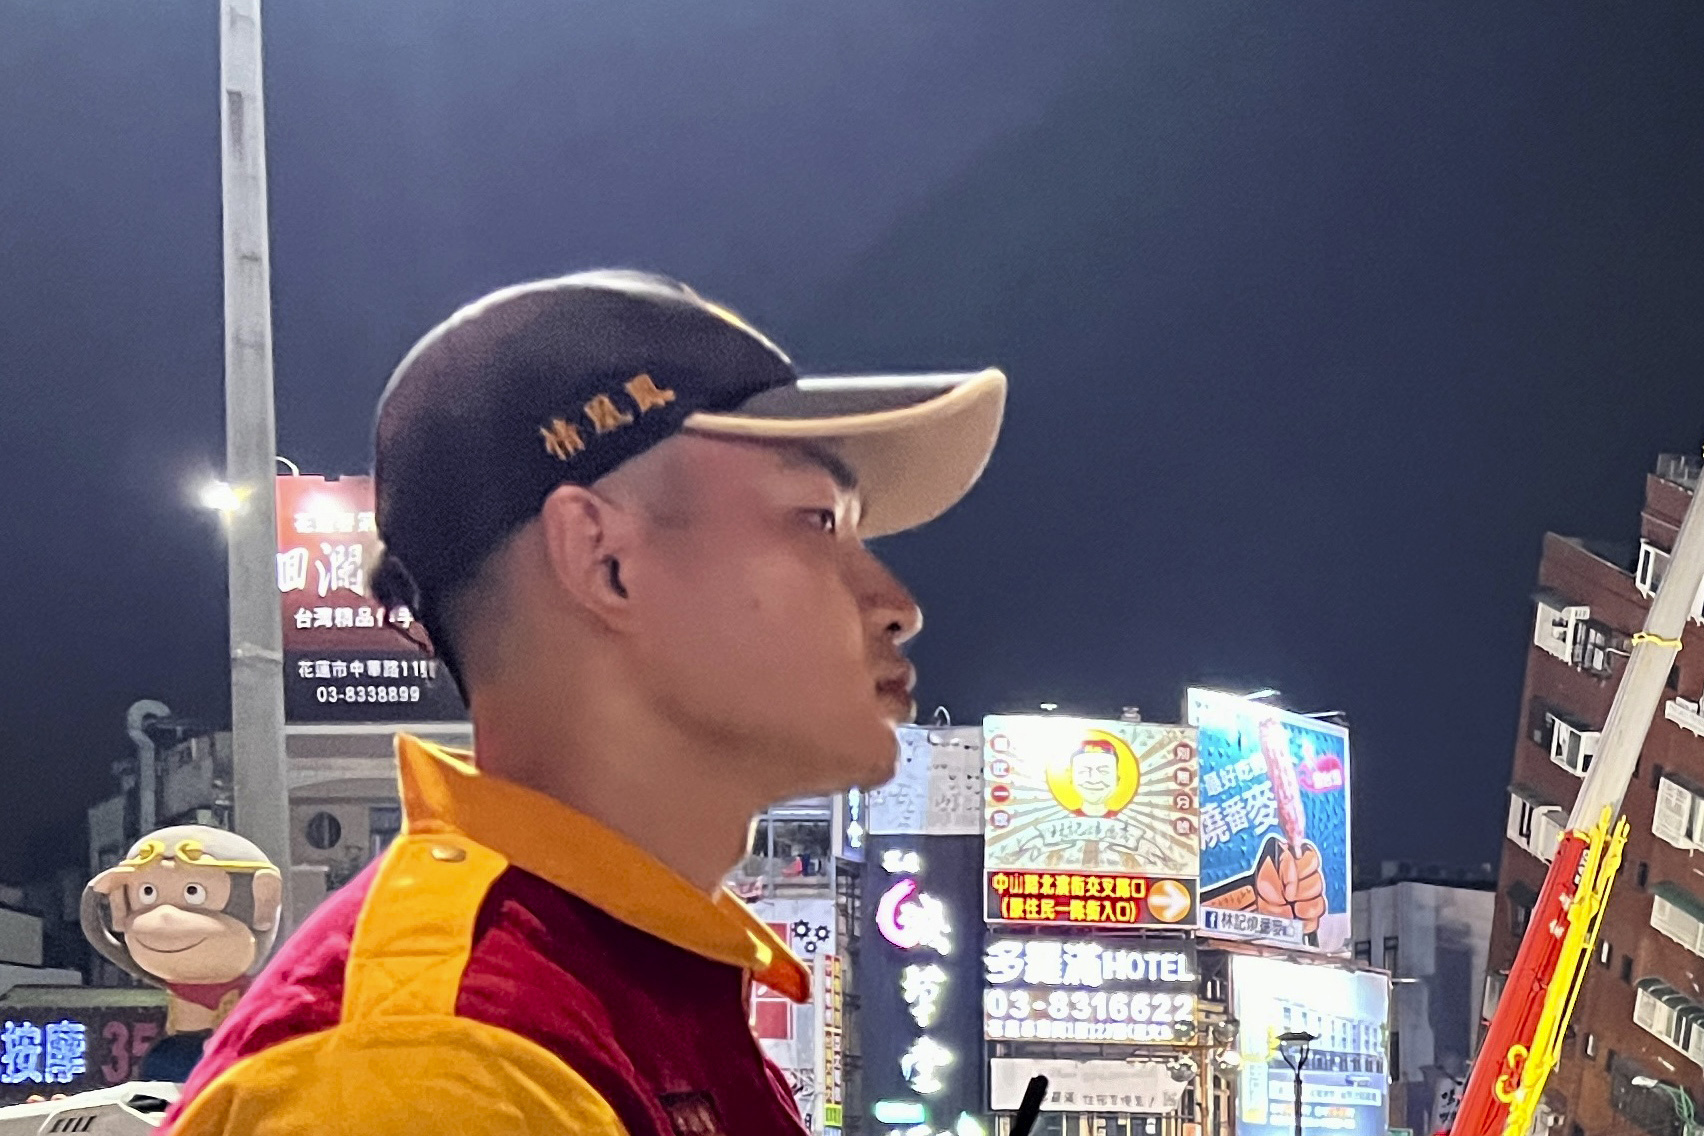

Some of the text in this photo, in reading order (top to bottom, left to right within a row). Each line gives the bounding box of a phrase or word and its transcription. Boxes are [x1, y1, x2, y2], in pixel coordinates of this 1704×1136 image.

[316, 686, 420, 702] 03-8338899
[1102, 950, 1195, 981] HOTEL
[987, 988, 1195, 1022] 03-8316622
[0, 1019, 87, 1084] 按摩
